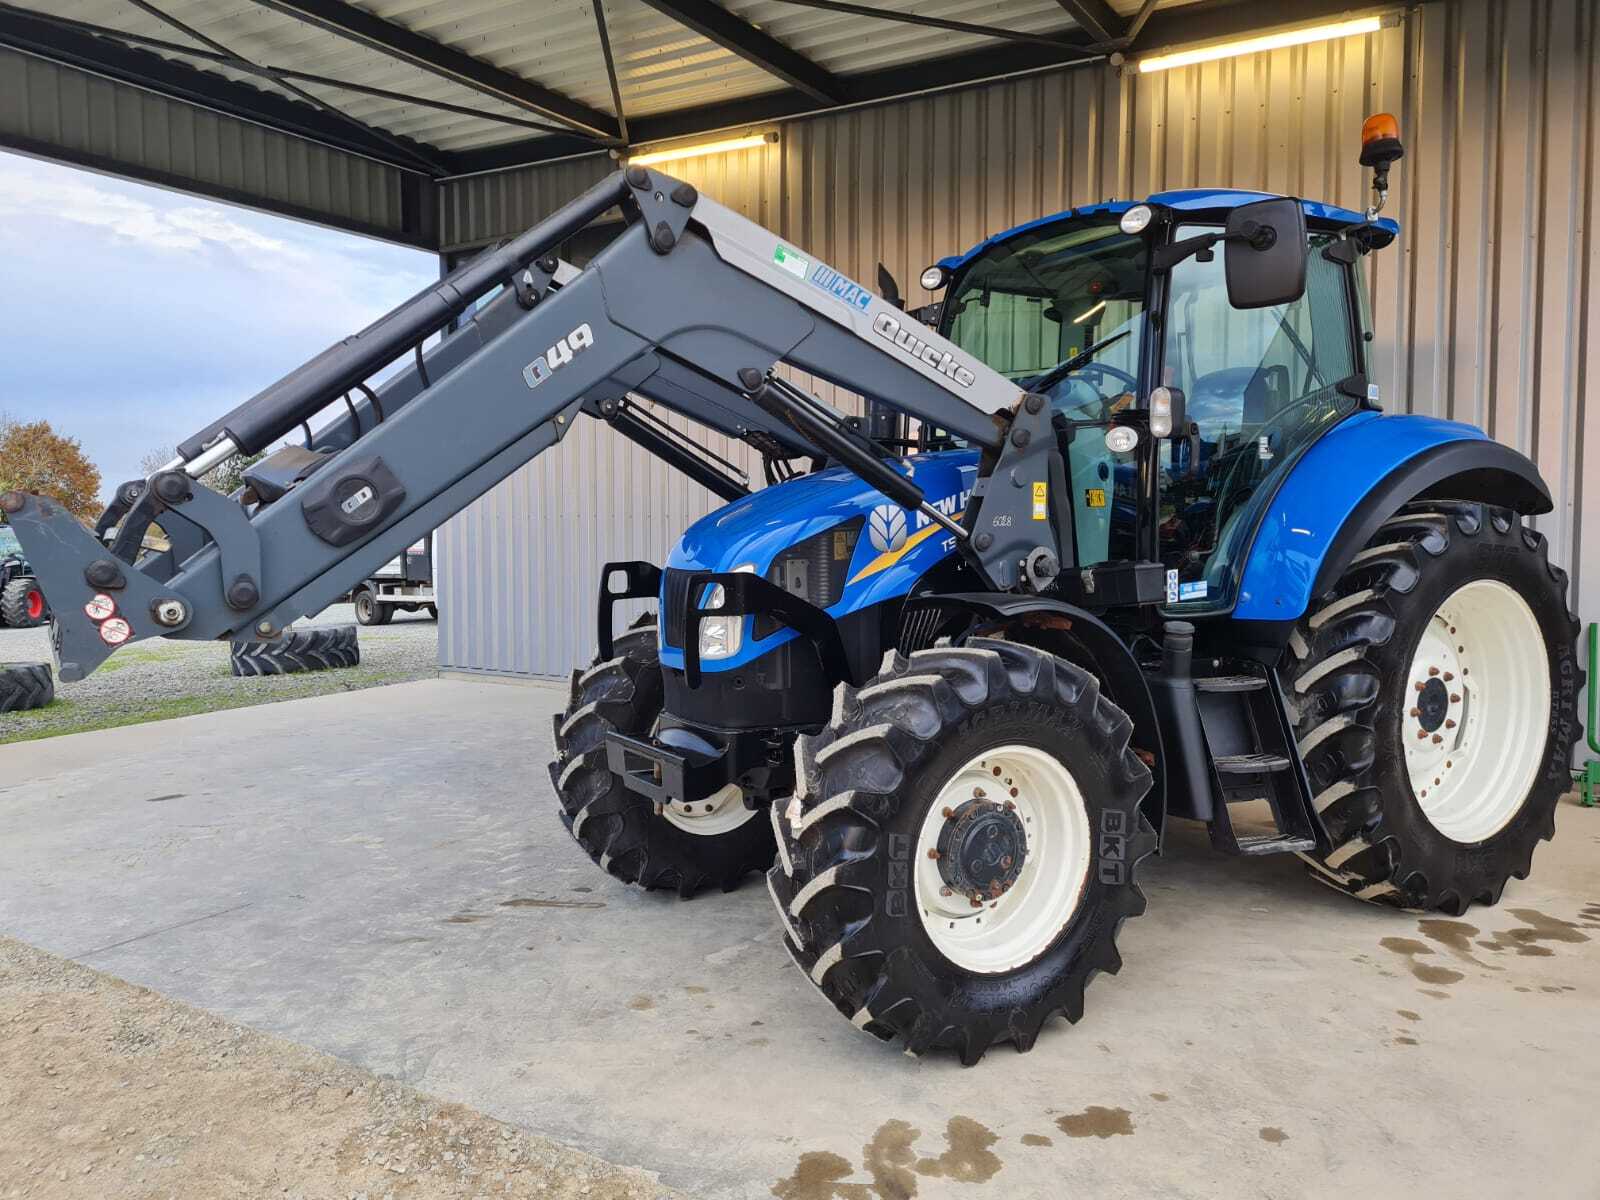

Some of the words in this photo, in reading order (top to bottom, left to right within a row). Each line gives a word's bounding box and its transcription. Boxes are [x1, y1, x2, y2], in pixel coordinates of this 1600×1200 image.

[873, 312, 976, 388] Quicke
[916, 494, 957, 528] NW
[1099, 808, 1127, 885] BKT
